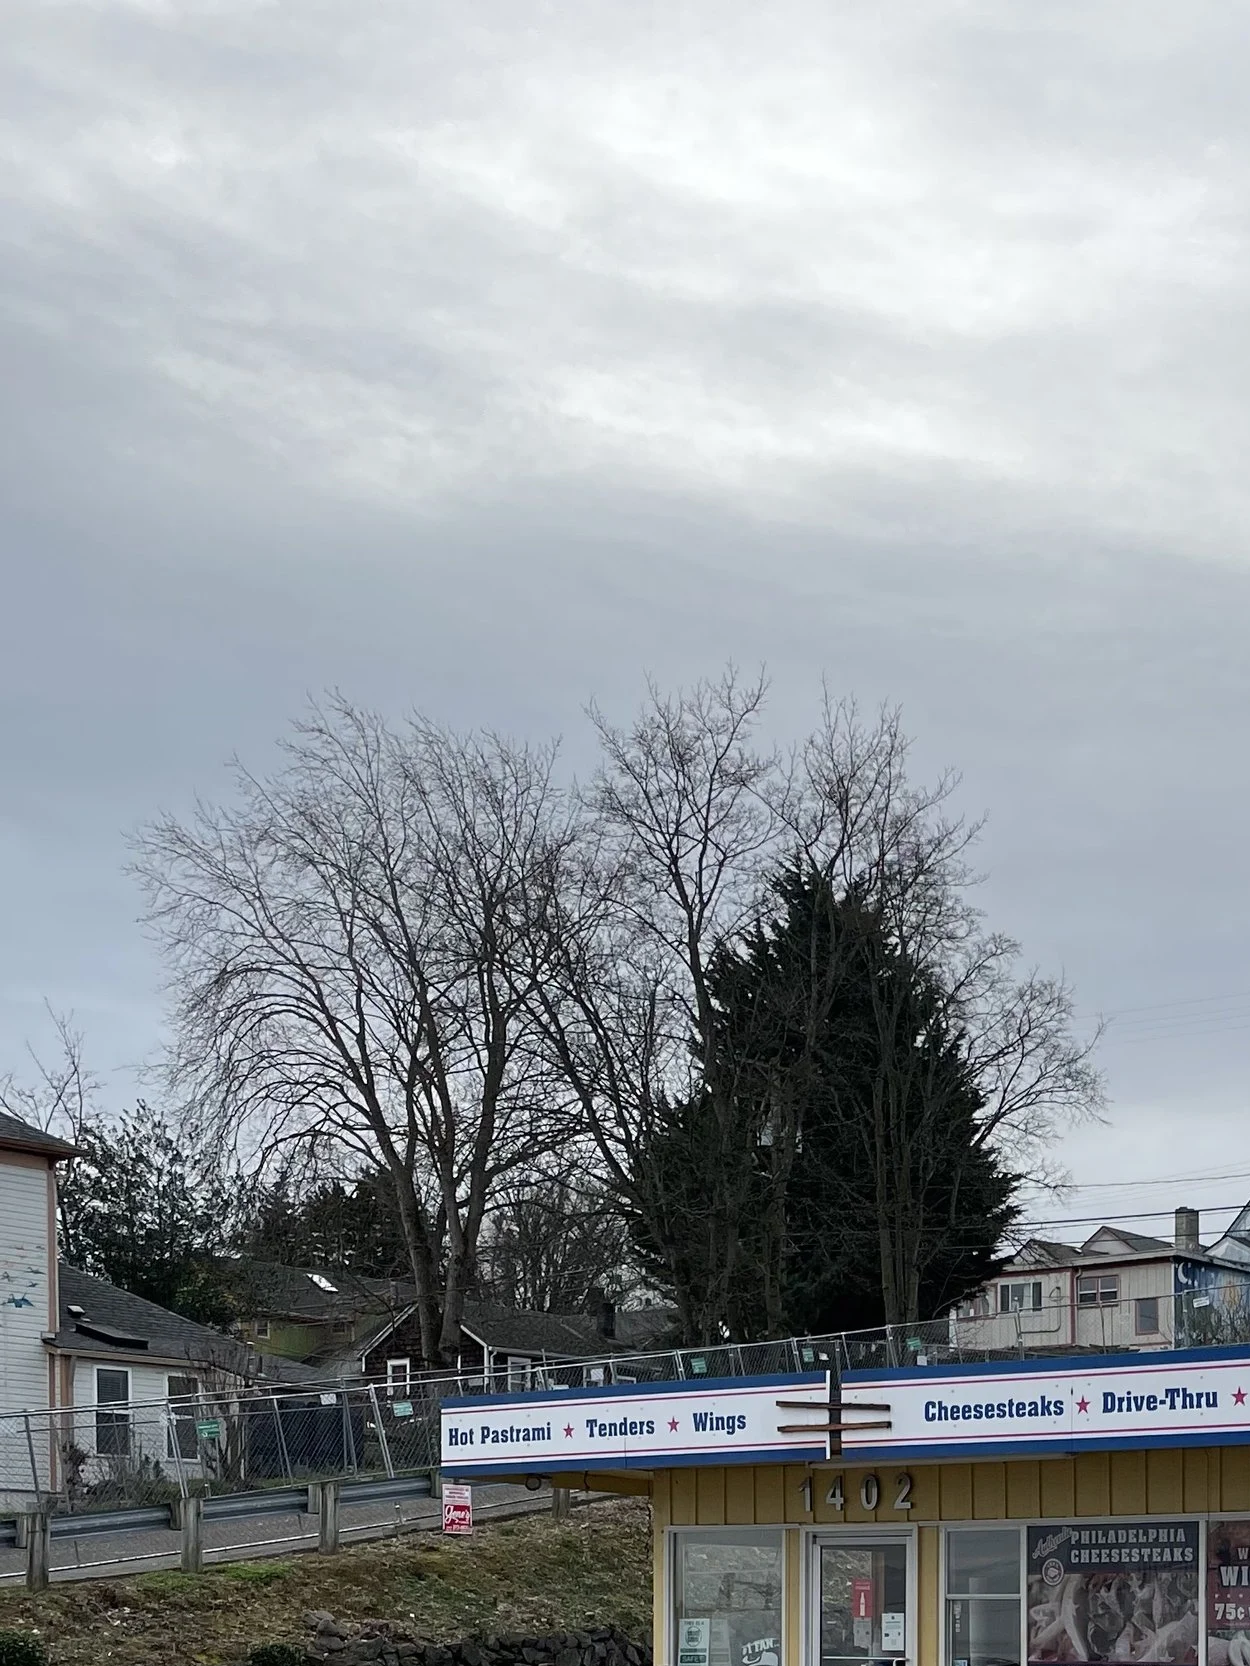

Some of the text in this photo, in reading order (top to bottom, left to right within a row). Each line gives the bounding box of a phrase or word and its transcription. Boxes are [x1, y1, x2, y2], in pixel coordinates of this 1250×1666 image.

[448, 1427, 475, 1447] Hot
[480, 1421, 551, 1445] Pastrami
[586, 1418, 655, 1438] Tenders
[692, 1412, 747, 1435] Wings
[924, 1395, 1064, 1423] Cheesesteaks
[1102, 1387, 1218, 1413] Drive-Thru
[799, 1472, 913, 1512] 1402
[1070, 1528, 1186, 1545] PHILADELPHIA
[1070, 1547, 1194, 1563] CHEESESTEAKS
[1214, 1603, 1245, 1620] 75¢
